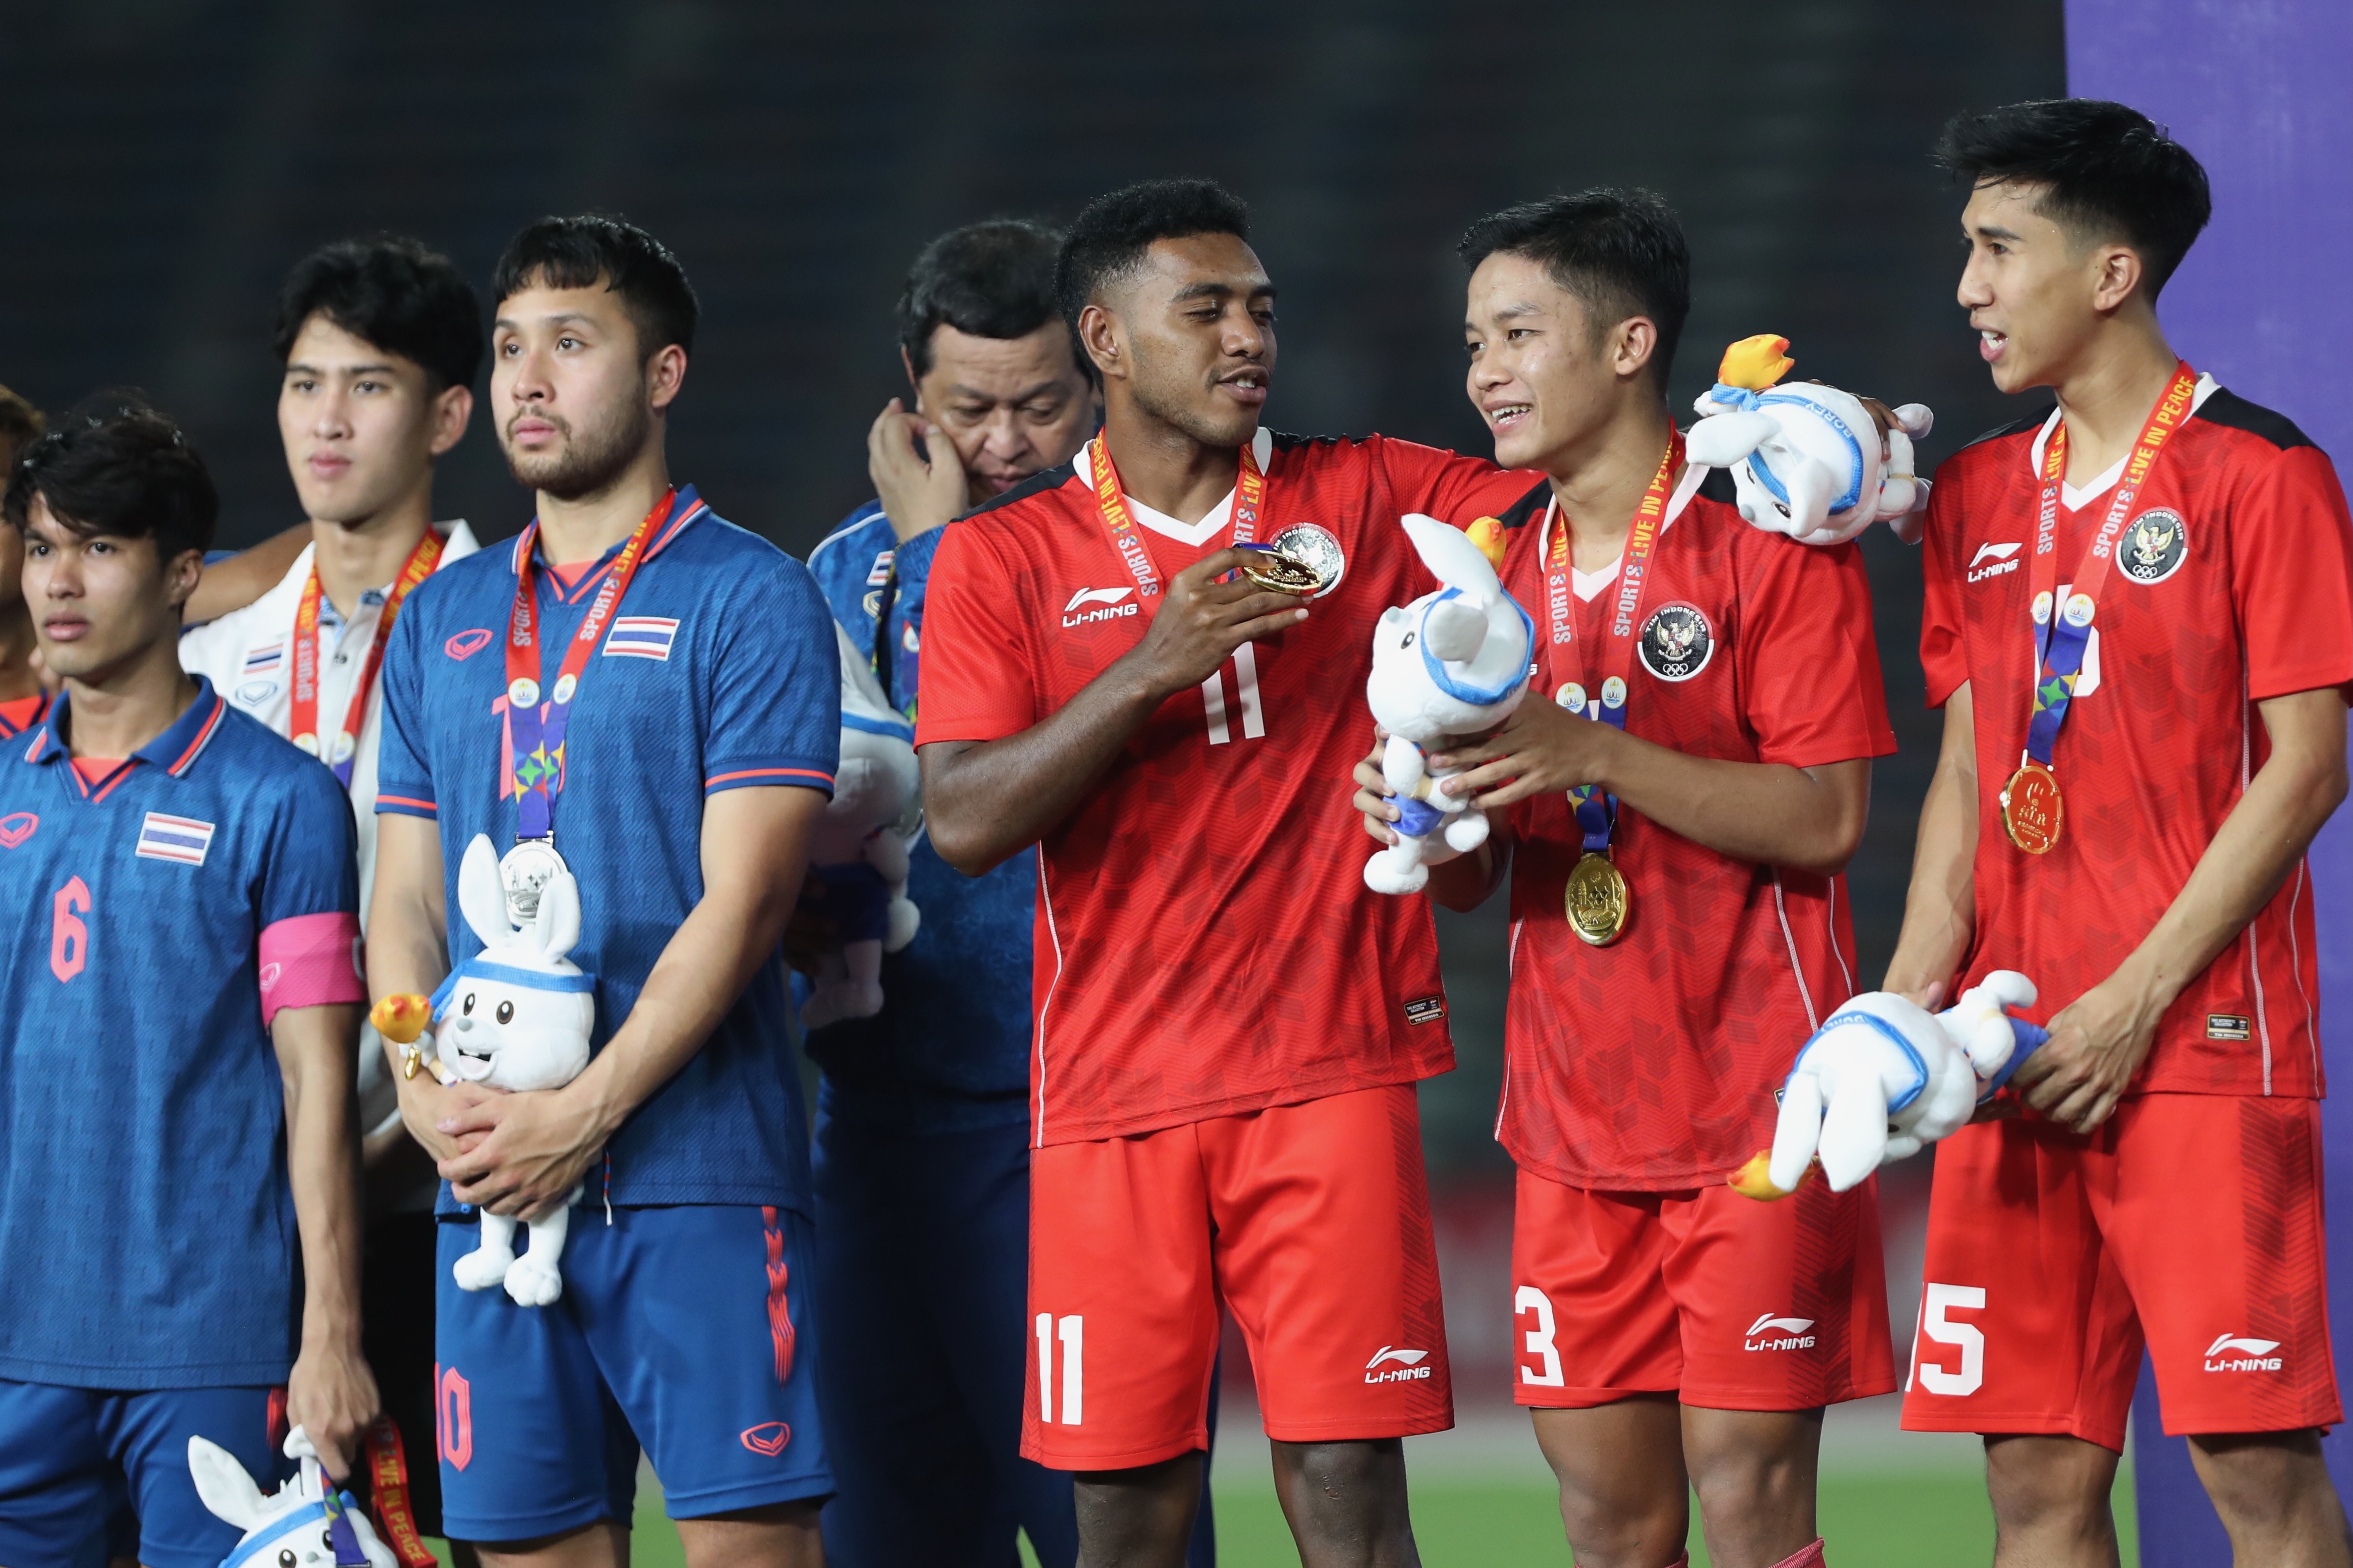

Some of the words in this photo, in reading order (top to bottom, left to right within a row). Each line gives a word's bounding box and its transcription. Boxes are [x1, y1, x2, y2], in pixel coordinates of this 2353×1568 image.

[2144, 426, 2169, 447] IN
[1099, 477, 1116, 500] IN
[1640, 495, 1662, 516] IN
[2128, 517, 2144, 533] TIM
[2146, 511, 2184, 540] INDONESIA
[1273, 539, 1282, 551] IM
[1282, 527, 1334, 549] INDONSIA
[1967, 558, 2019, 582] LI-NING
[1062, 603, 1138, 627] LI-NING
[1645, 615, 1659, 633] TIM
[1660, 606, 1707, 632] INDONESIA
[51, 875, 91, 983] 6
[1514, 1285, 1565, 1387] 3
[1745, 1335, 1816, 1352] LI-NING
[1035, 1311, 1084, 1426] 11
[1365, 1365, 1431, 1384] LI-NING
[2204, 1357, 2283, 1372] LI-NING
